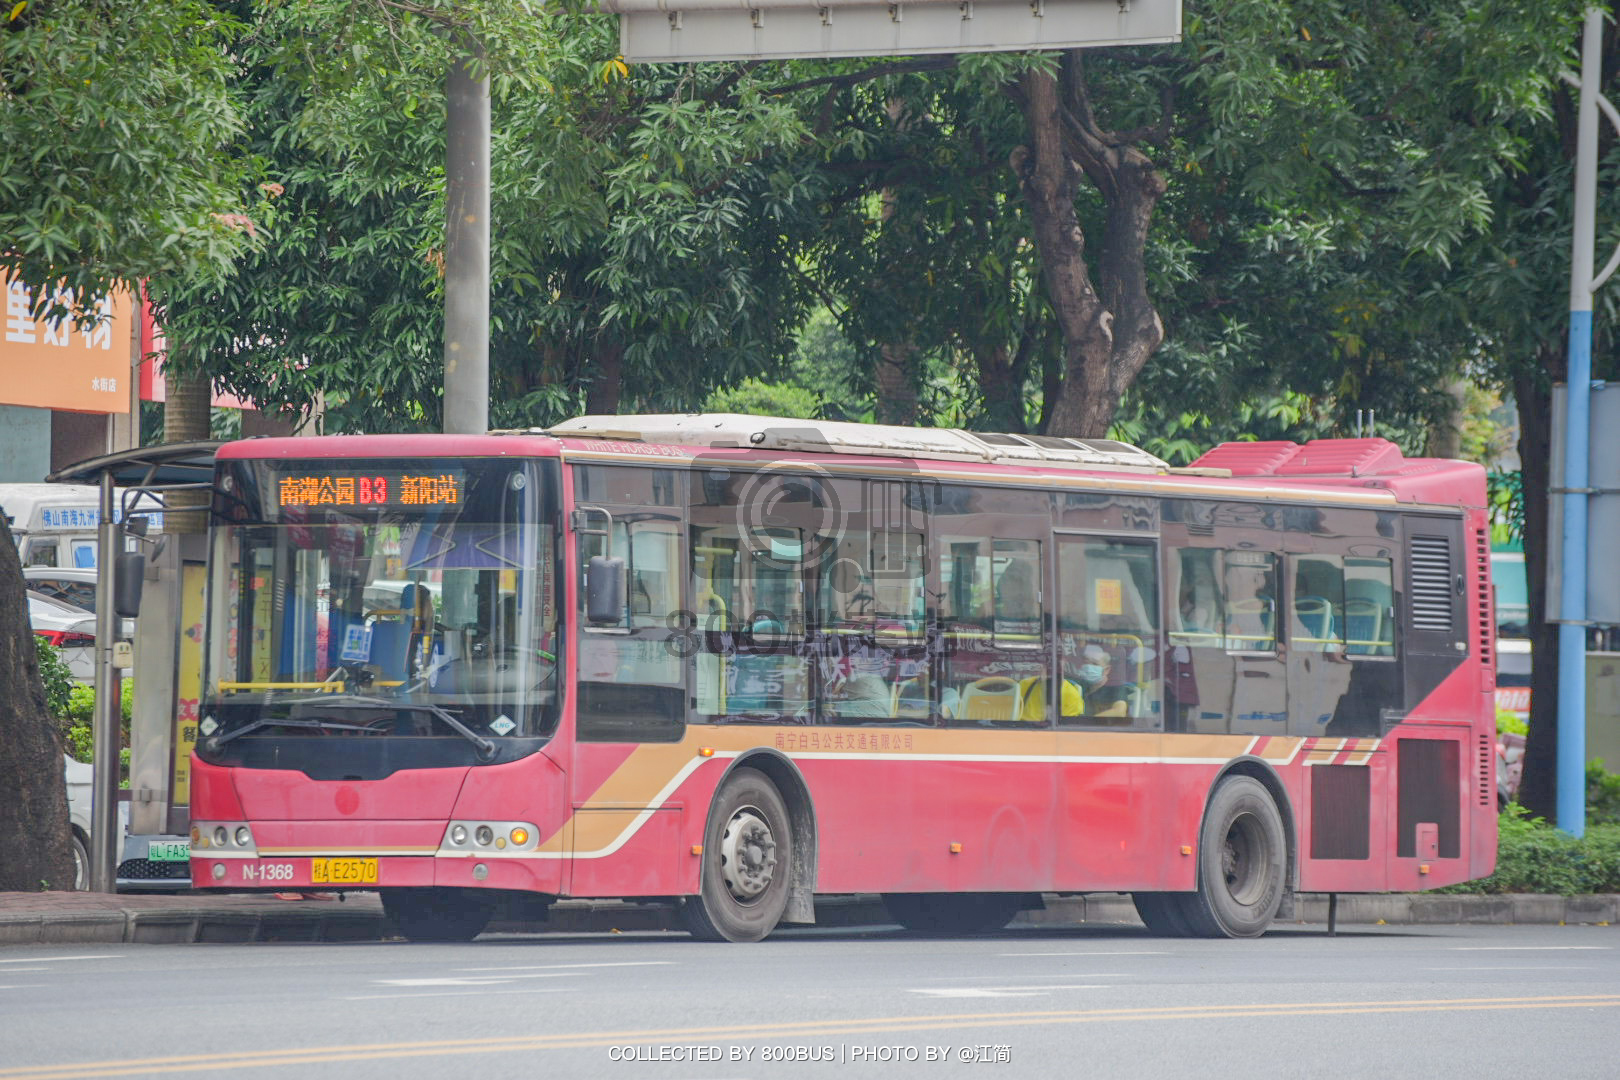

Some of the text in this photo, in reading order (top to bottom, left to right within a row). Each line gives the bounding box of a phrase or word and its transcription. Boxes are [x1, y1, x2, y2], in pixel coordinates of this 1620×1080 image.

[91, 377, 117, 393] 水街店
[622, 443, 659, 455] HORSE
[658, 445, 683, 457] BUS
[279, 474, 458, 506] 南湖公园 B3 新阳站
[775, 731, 913, 750] 南宁白马公共交通有限公司
[243, 864, 294, 880] N-1368
